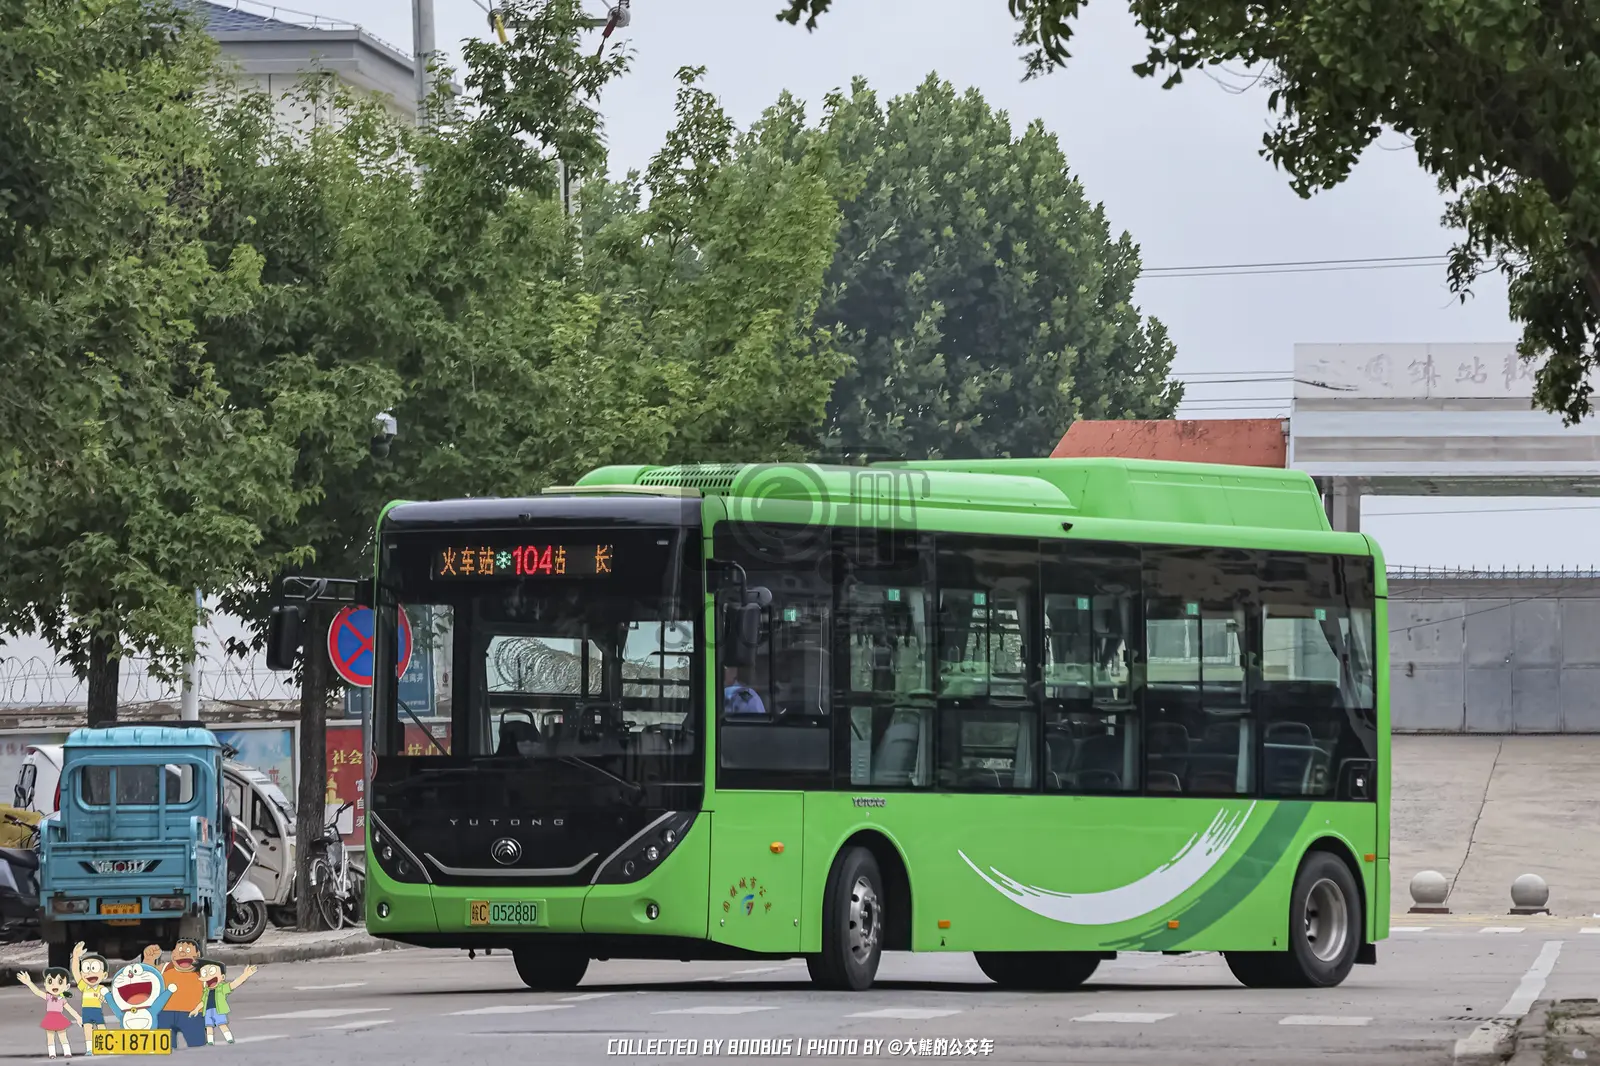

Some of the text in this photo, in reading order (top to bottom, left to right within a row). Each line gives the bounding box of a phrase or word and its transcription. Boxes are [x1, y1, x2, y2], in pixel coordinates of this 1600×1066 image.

[440, 546, 494, 576] 火车站
[512, 545, 553, 575] 104
[331, 749, 364, 766] 社会
[449, 818, 564, 826] YUTONG
